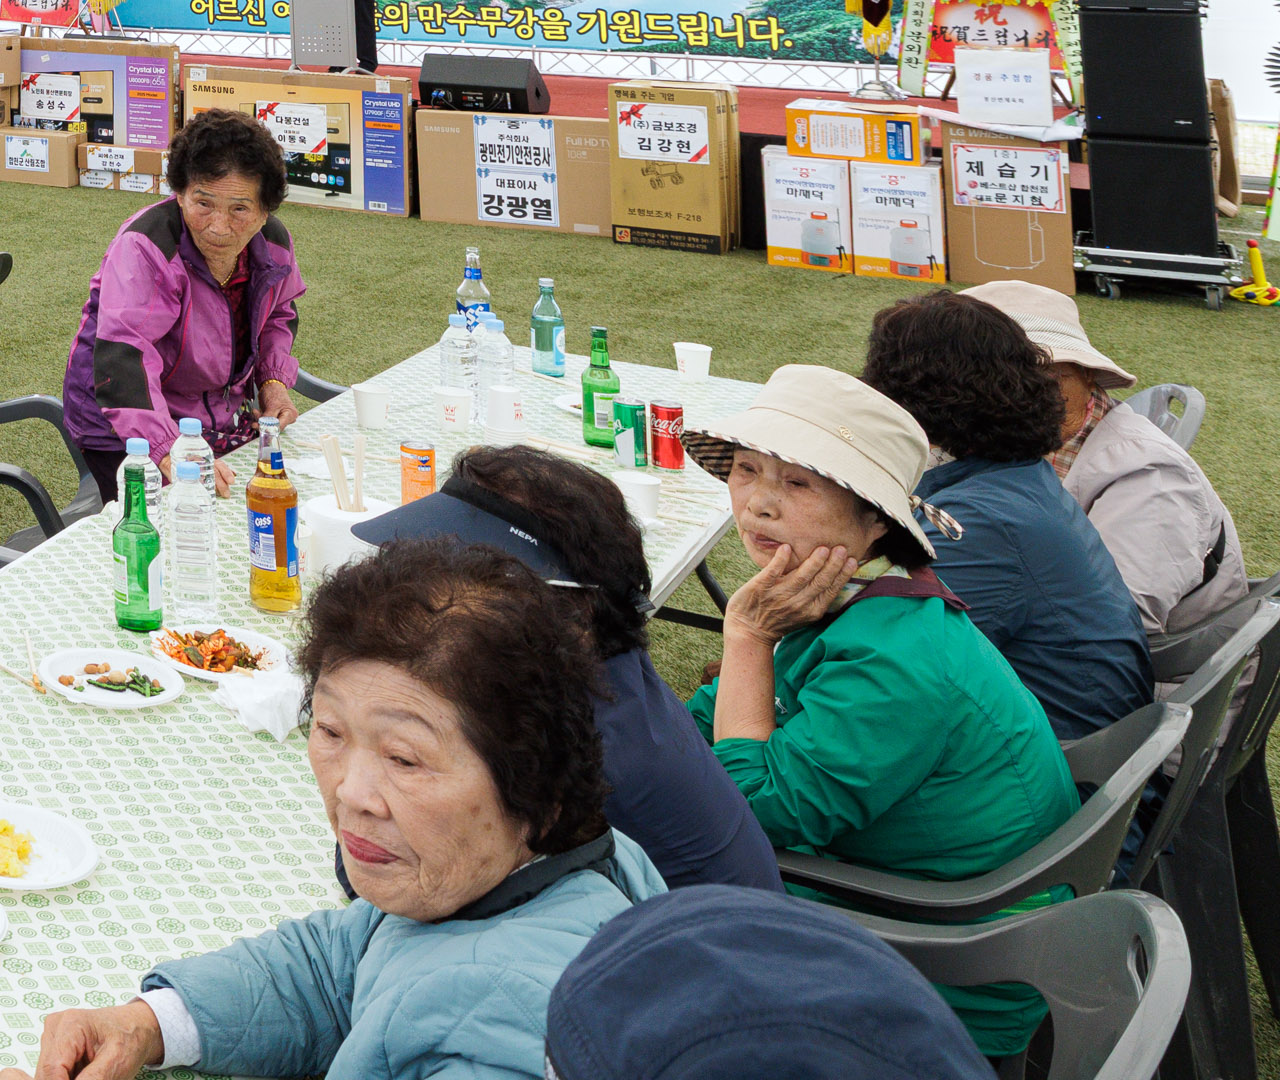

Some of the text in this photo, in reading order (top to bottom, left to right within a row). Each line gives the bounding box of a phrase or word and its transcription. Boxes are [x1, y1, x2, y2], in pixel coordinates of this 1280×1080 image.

[973, 3, 1009, 26] 祝
[416, 1, 571, 41] 만수무강을
[576, 9, 794, 52] 기원드립니다.
[128, 65, 166, 75] Crystal UHD
[192, 84, 236, 95] SAMSUNG
[639, 89, 657, 101] 주는
[659, 91, 676, 103] 기업
[364, 99, 388, 108] Crystal
[423, 124, 461, 134] SAMSUNG
[632, 119, 698, 135] (주) 금보조경
[949, 127, 966, 137] LG
[497, 133, 530, 144] 주식회사
[565, 136, 584, 146] Full
[584, 137, 600, 147] HD
[636, 136, 692, 155] 김강현
[479, 143, 552, 167] 광민전기안전공사
[965, 160, 1050, 181] 제습기
[495, 177, 538, 192] 대표이사
[786, 187, 824, 201] 마재덕
[482, 193, 553, 222] 강광열
[875, 195, 915, 209] 마재덕
[627, 207, 702, 223] 보행보조차 F-218
